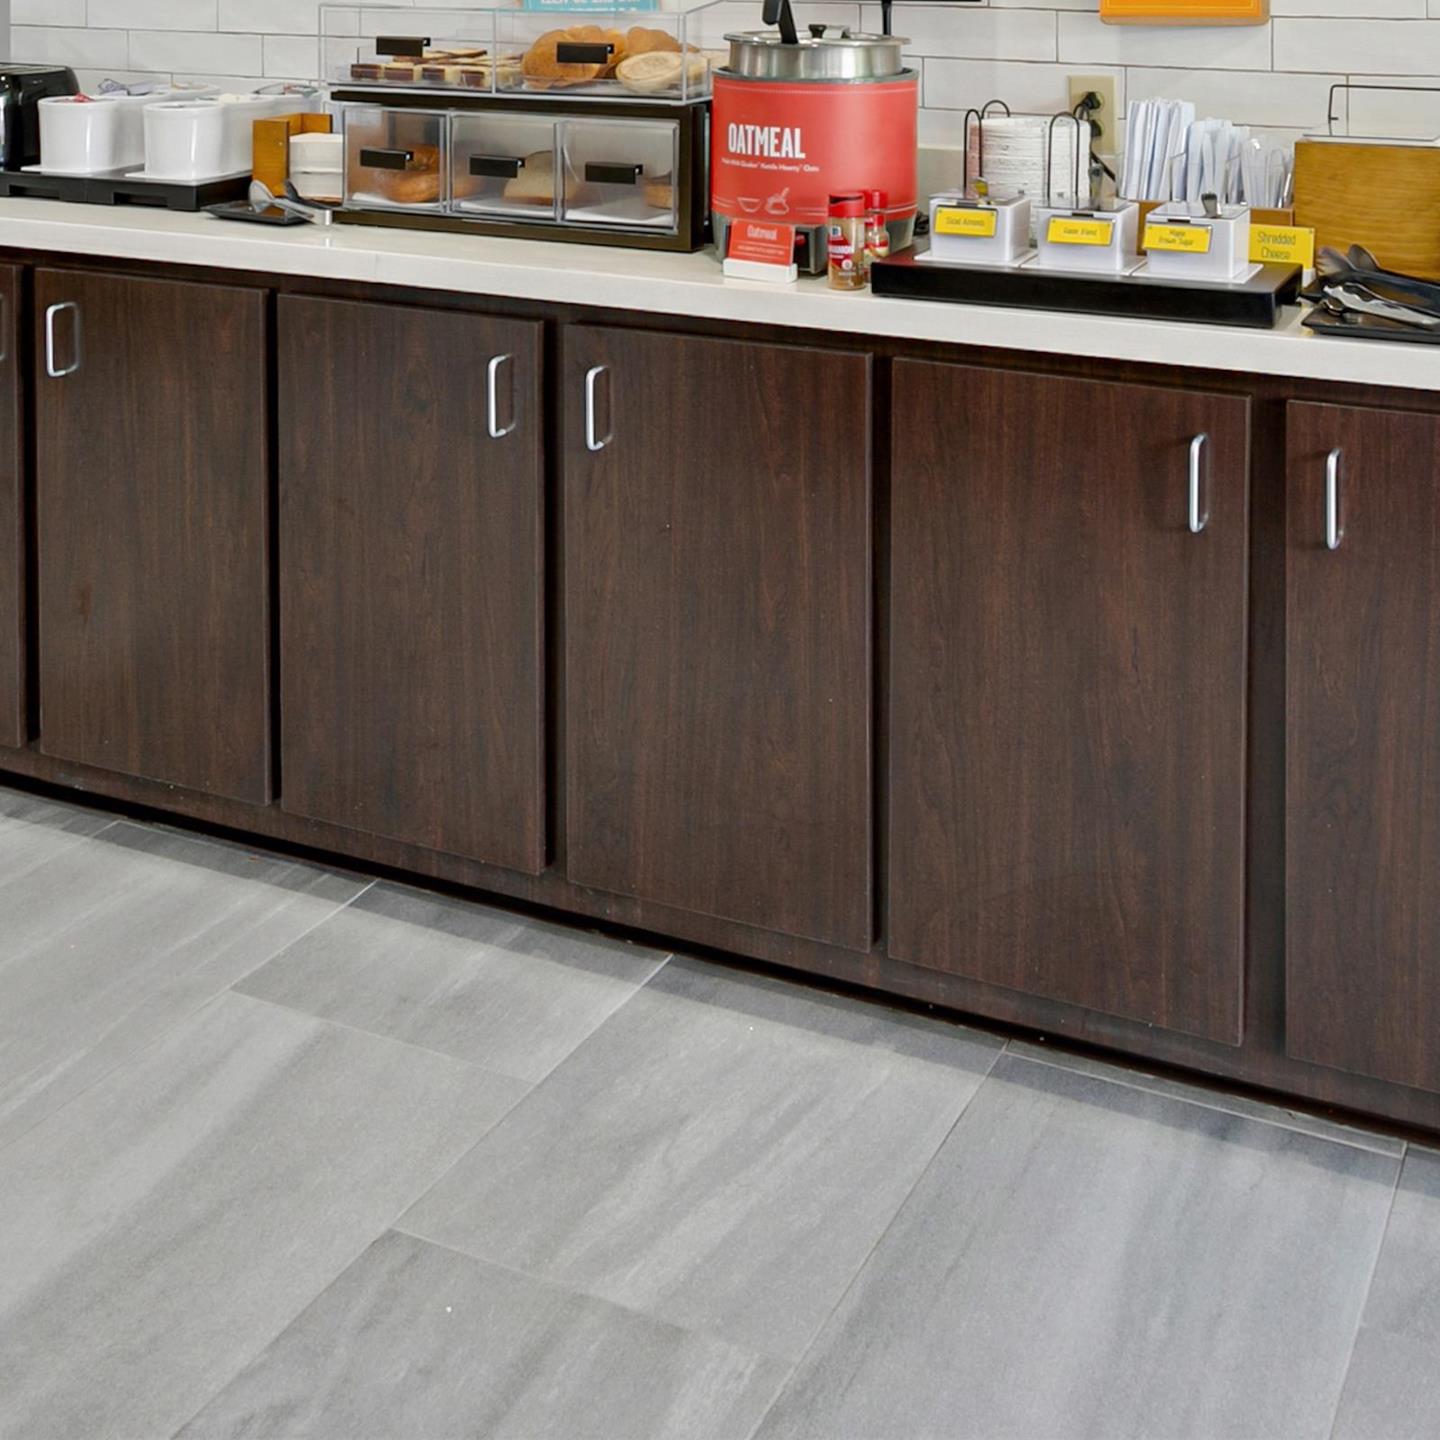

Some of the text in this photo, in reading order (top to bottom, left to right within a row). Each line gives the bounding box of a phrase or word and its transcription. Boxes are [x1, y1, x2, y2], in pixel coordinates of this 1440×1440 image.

[728, 123, 806, 159] OATMEAL
[1257, 231, 1297, 246] Shredded
[1262, 247, 1291, 260] Cheese
